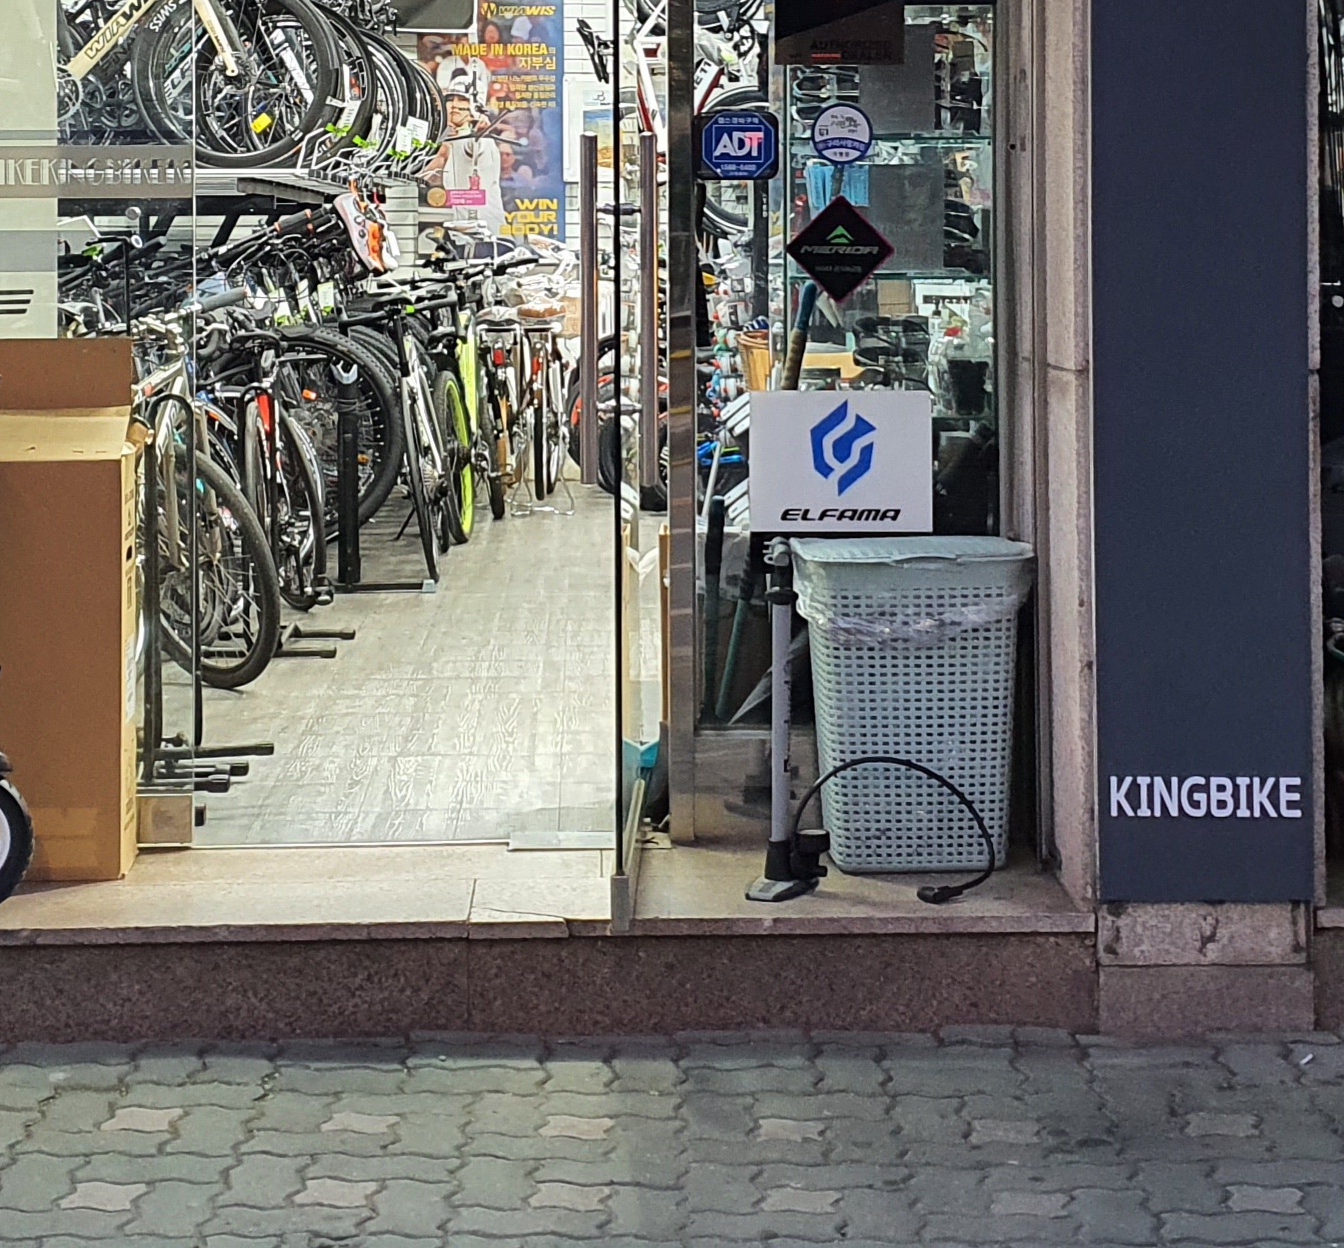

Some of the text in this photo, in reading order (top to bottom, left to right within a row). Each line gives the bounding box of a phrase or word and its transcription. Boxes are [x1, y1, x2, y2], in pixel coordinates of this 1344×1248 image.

[499, 5, 557, 16] WIAWIS
[452, 43, 486, 56] MADE
[490, 43, 504, 56] IN
[713, 131, 764, 157] ADT
[515, 198, 558, 210] WIN
[504, 211, 557, 223] YOUR
[499, 224, 558, 235] BODY!
[800, 245, 879, 254] MERIDA
[780, 507, 902, 523] ELFAMA
[1109, 775, 1303, 818] KINGBIKE
